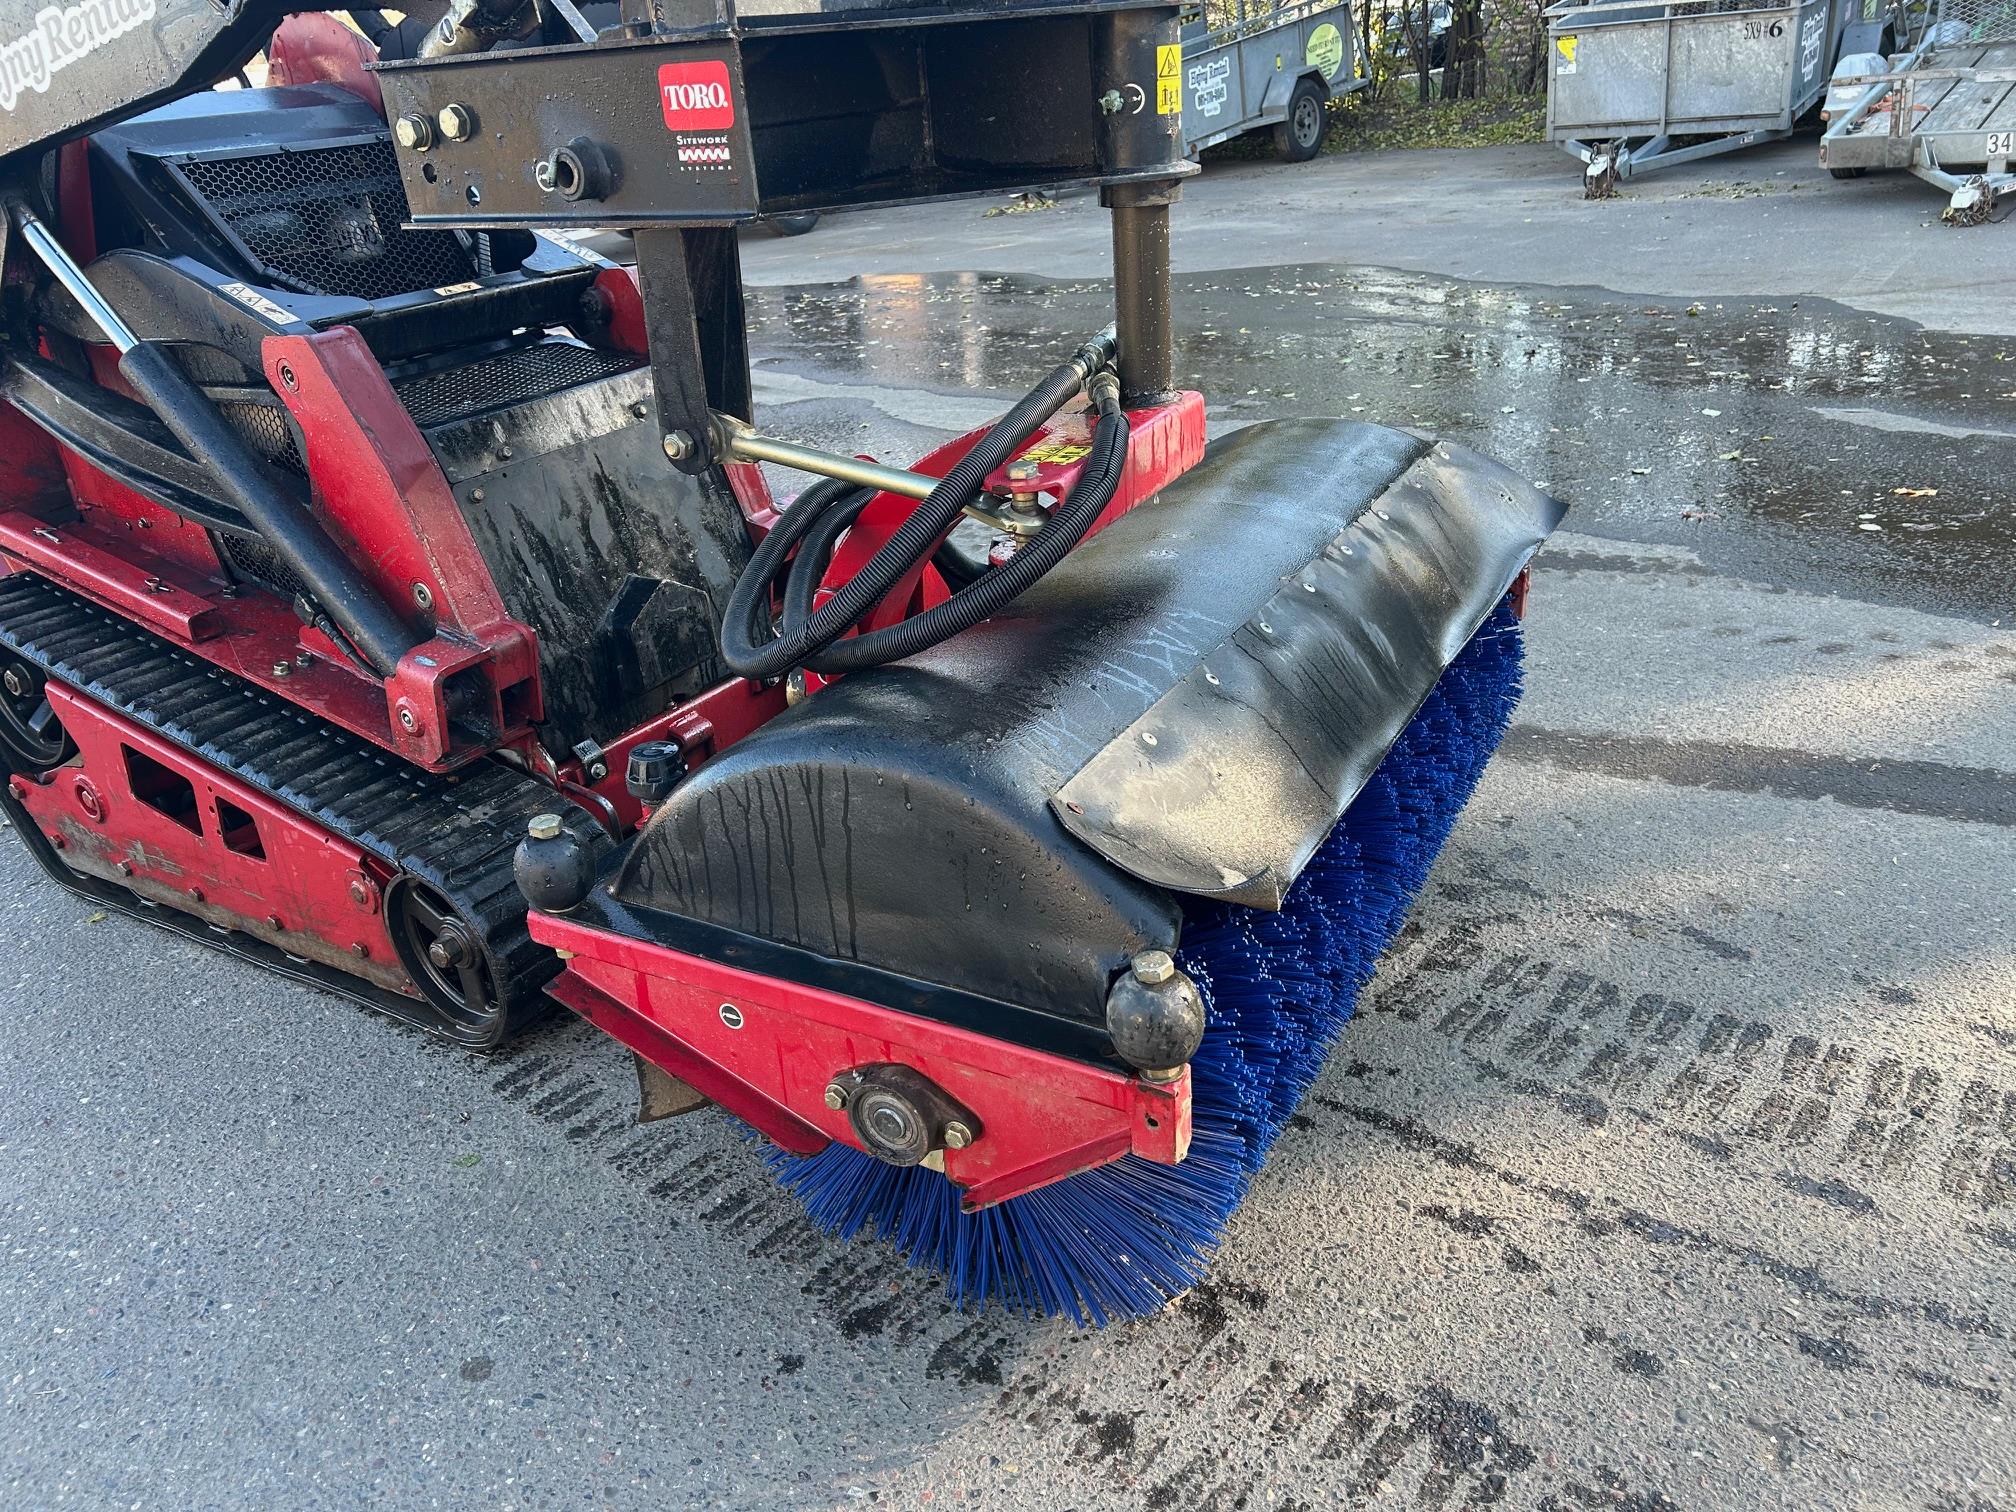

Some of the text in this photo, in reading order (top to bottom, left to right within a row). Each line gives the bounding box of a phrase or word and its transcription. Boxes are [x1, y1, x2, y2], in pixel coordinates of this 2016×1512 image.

[40, 0, 153, 63] Renta
[1744, 21, 1761, 40] 5X9
[1988, 133, 2011, 154] 34
